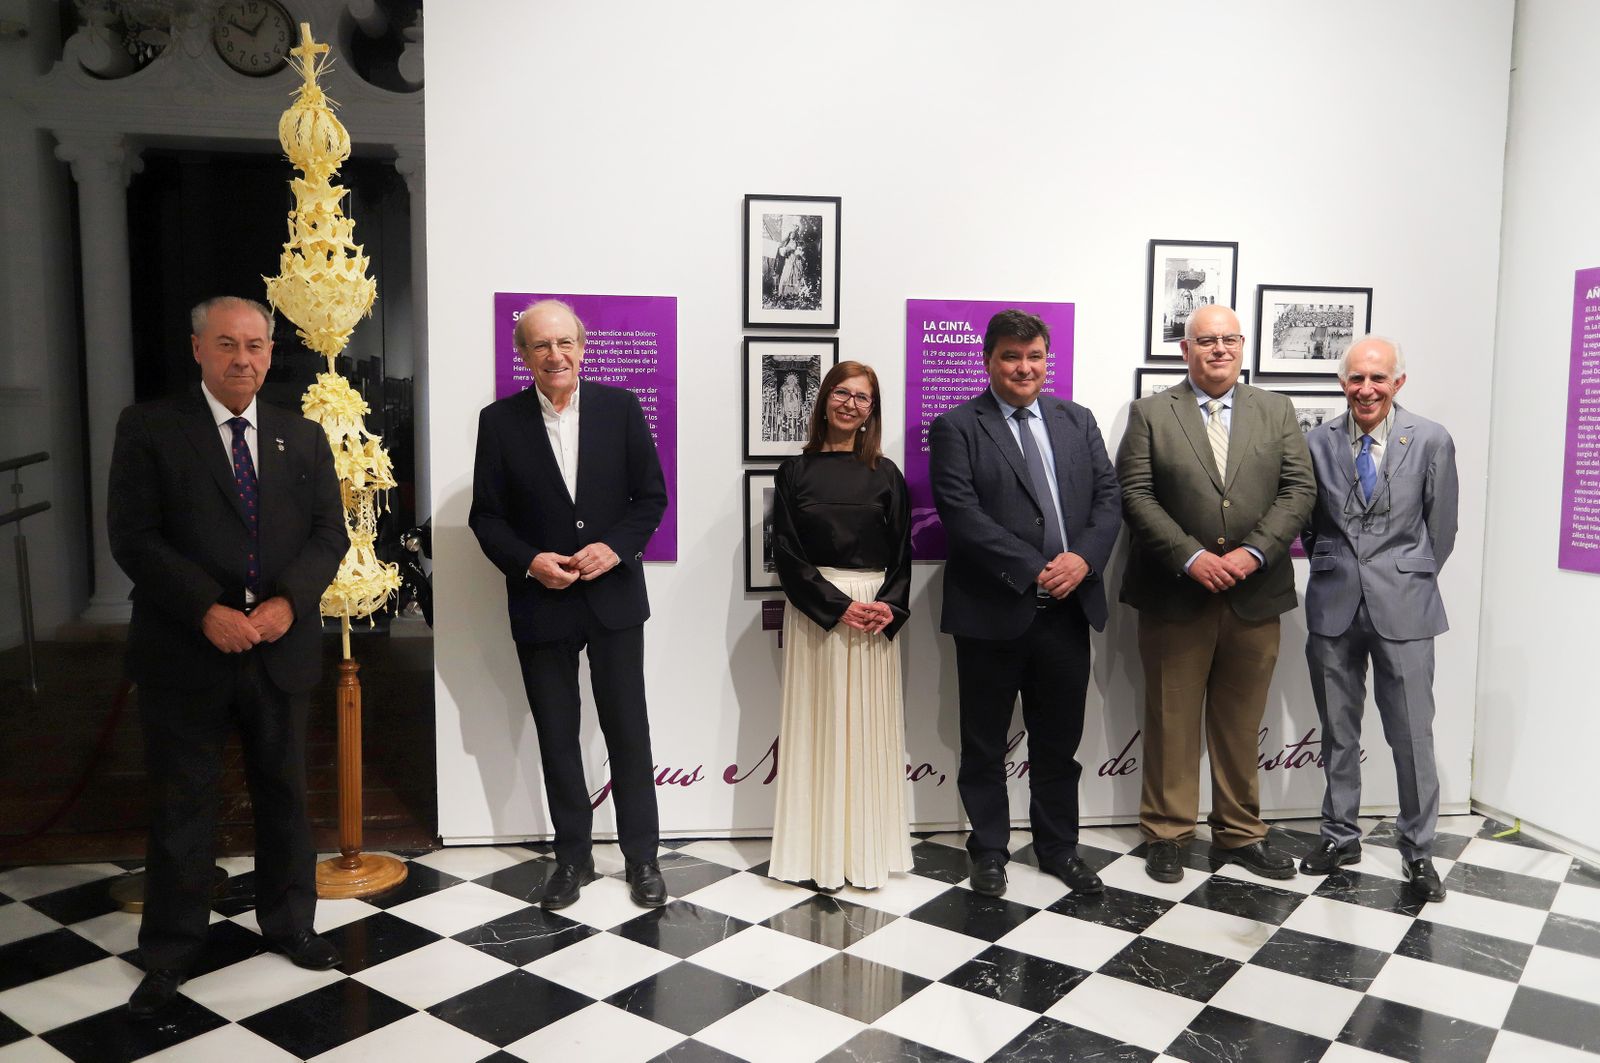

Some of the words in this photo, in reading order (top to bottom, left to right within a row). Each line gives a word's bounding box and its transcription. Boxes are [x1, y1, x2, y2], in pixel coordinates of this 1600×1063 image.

[923, 320, 937, 331] LA
[938, 320, 974, 332] CINTA.
[598, 329, 622, 337] bendice
[635, 330, 658, 338] Doloro-
[922, 333, 983, 344] ALCALDESA
[609, 347, 623, 355] deja
[946, 350, 967, 358] agosto
[617, 357, 641, 365] Dolores
[651, 357, 658, 365] la
[600, 366, 634, 374] Procesiona
[922, 367, 958, 375] unanimidad,
[965, 368, 985, 376] Virgen
[922, 376, 951, 384] alcaldesa
[951, 377, 979, 385] perpetua
[936, 393, 952, 401] lugar
[1098, 729, 1140, 777] de
